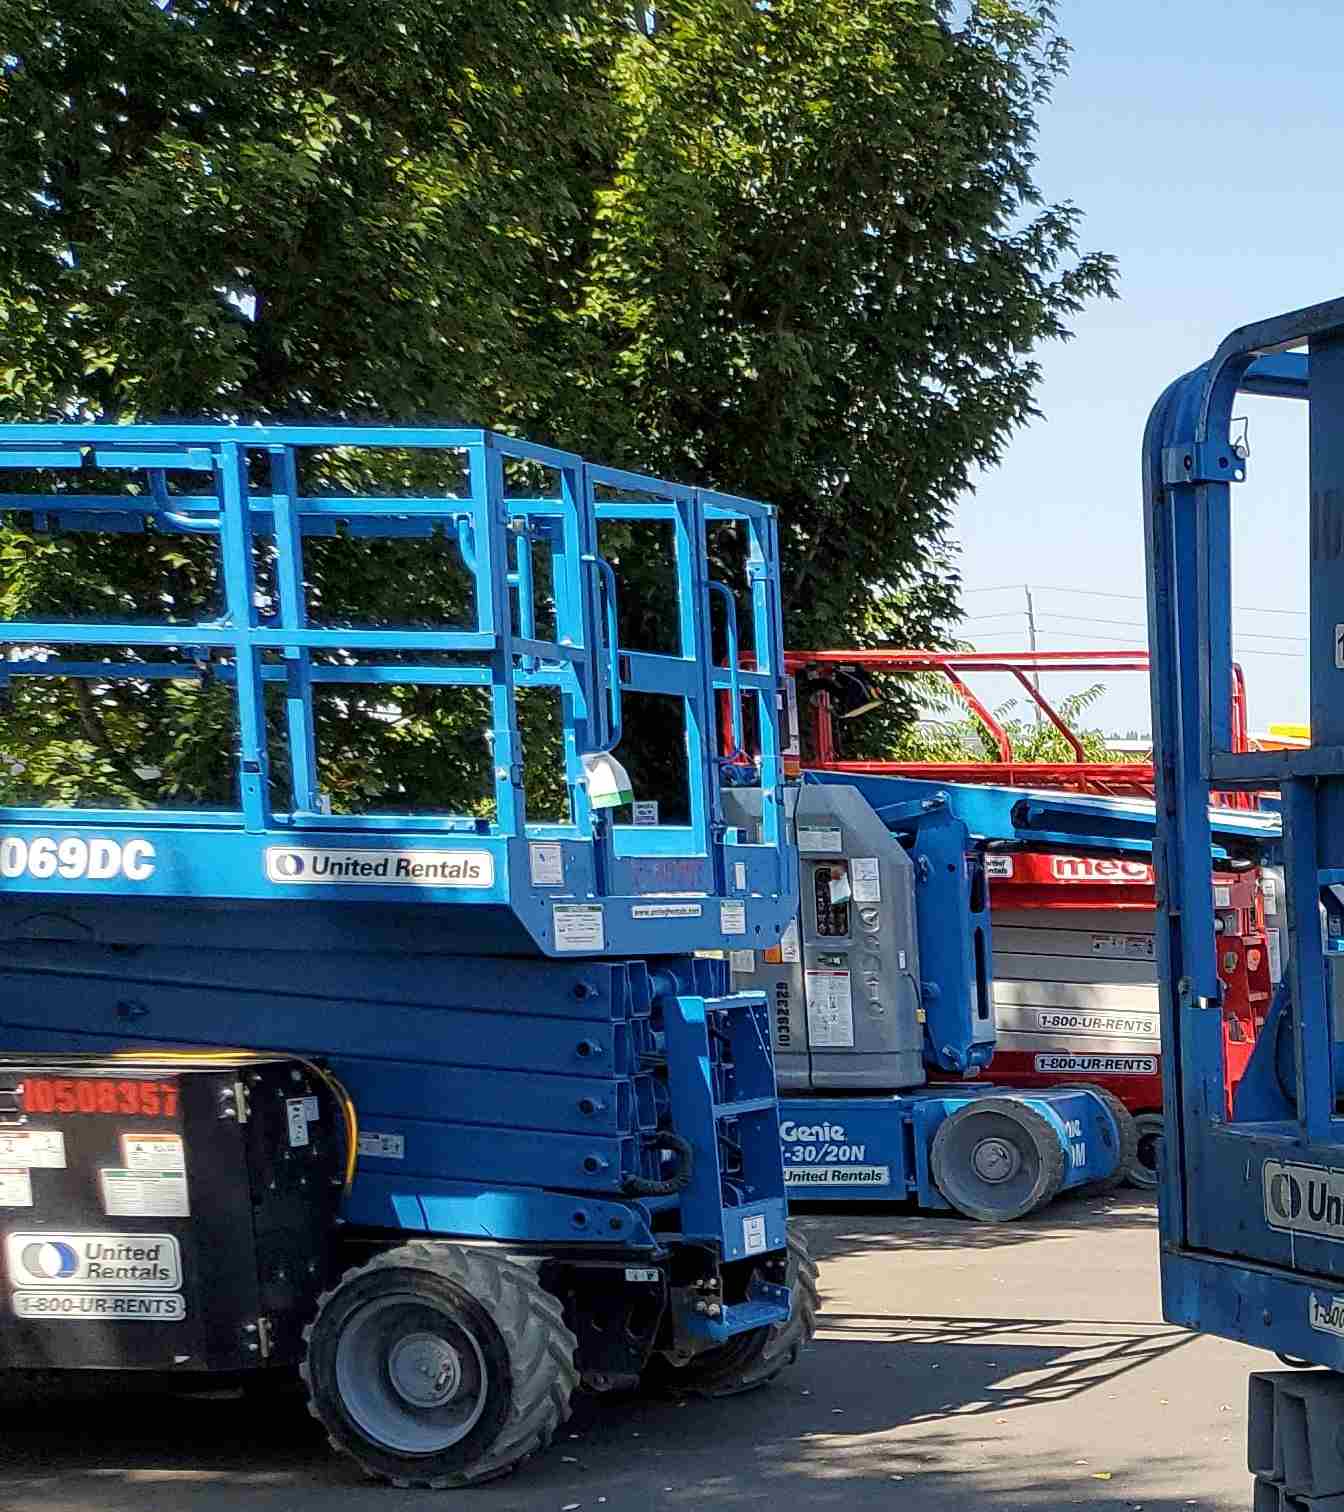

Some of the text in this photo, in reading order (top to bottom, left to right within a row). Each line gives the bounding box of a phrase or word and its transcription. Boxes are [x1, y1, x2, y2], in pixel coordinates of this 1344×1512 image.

[311, 855, 481, 880] United Rentals
[1055, 859, 1146, 877] mec
[1040, 1015, 1153, 1033] 1-800-UR-RENTS
[1039, 1058, 1153, 1071] 1-800-UR-RENTS
[24, 1078, 177, 1117] 10508357
[779, 1121, 845, 1141] Genie
[782, 1143, 865, 1162] -30/20N
[784, 1169, 882, 1182] United Rentals
[85, 1243, 161, 1261] United
[88, 1262, 171, 1281] Rentals
[22, 1297, 178, 1314] 1-800-UR-RENTS
